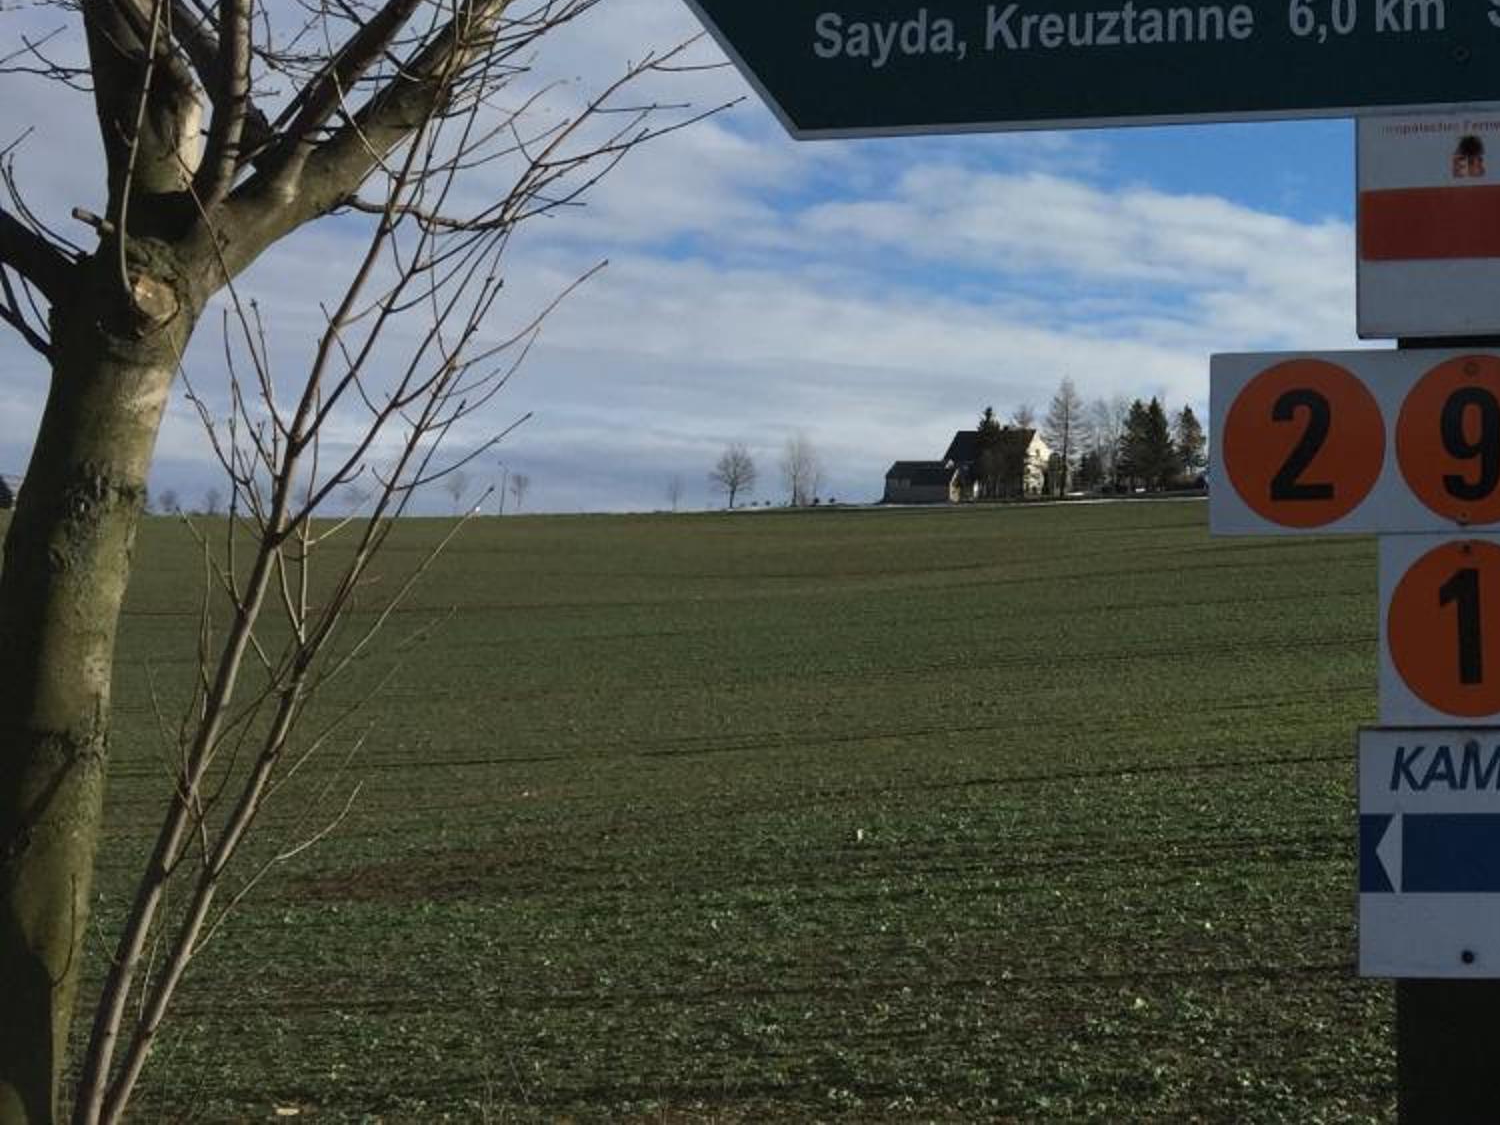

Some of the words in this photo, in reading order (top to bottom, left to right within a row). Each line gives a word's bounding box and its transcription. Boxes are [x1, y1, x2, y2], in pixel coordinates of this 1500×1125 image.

[813, 9, 967, 69] Sayda,
[985, 1, 1254, 51] Kreuztanne
[1269, 388, 1336, 502] 2
[1438, 567, 1483, 686] 1
